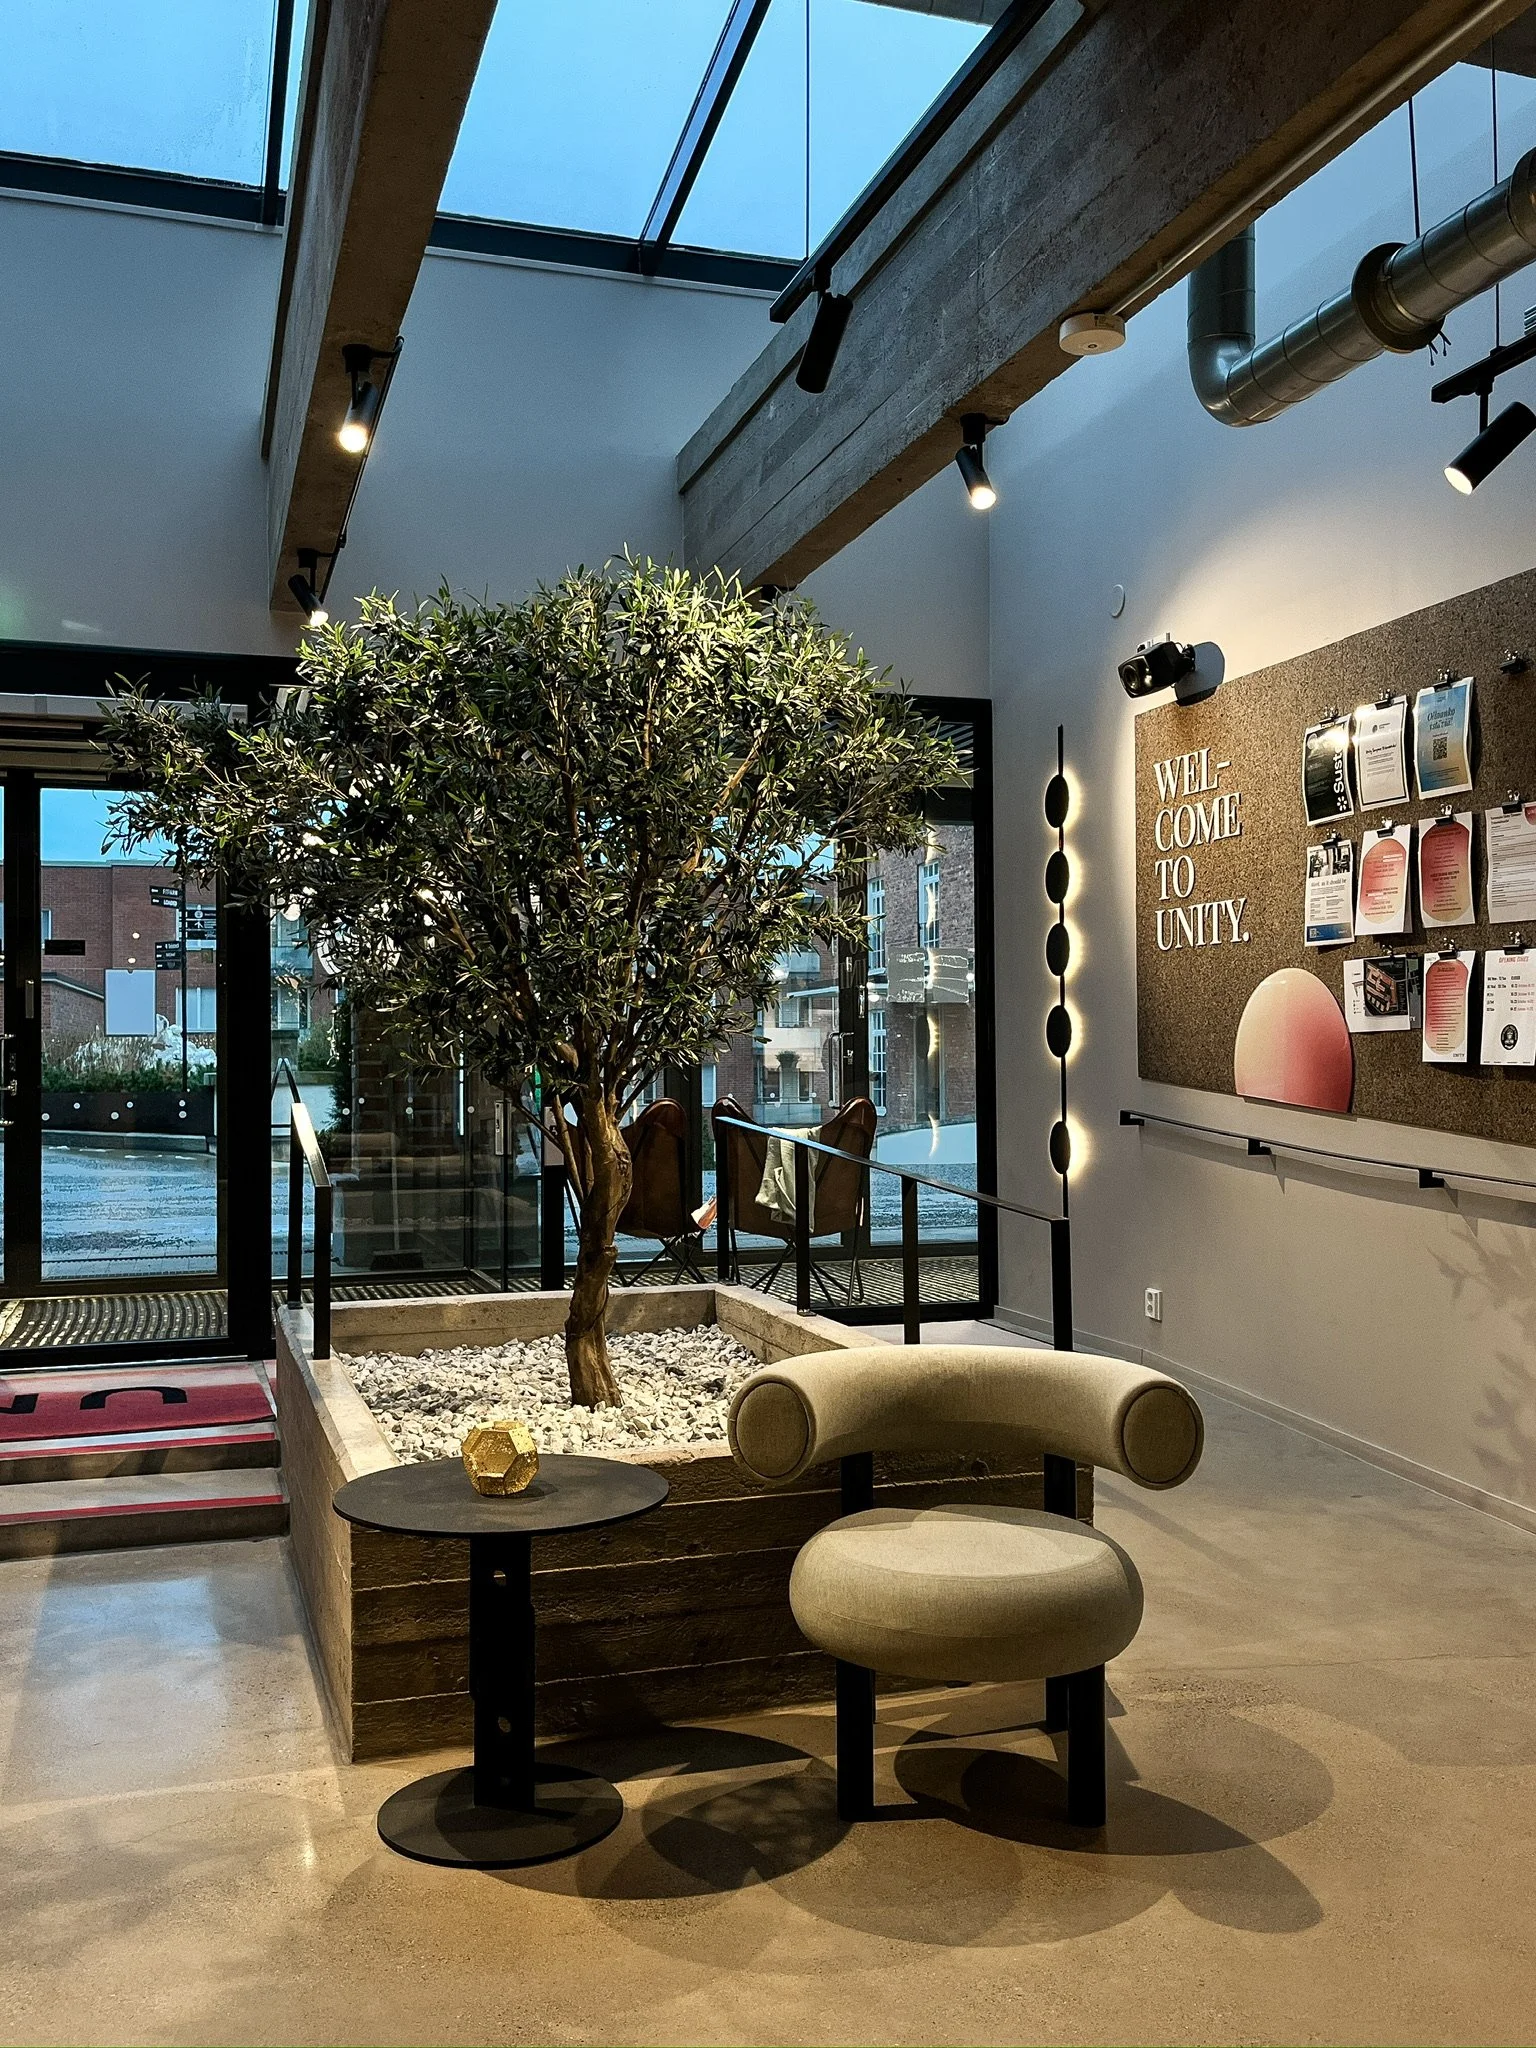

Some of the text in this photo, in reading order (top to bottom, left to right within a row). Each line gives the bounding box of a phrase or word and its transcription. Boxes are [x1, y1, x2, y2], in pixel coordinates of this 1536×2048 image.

[1153, 747, 1232, 803] WEL-
[1154, 792, 1243, 852] COME
[1154, 855, 1196, 902] TO
[1155, 897, 1250, 951] UNITY.
